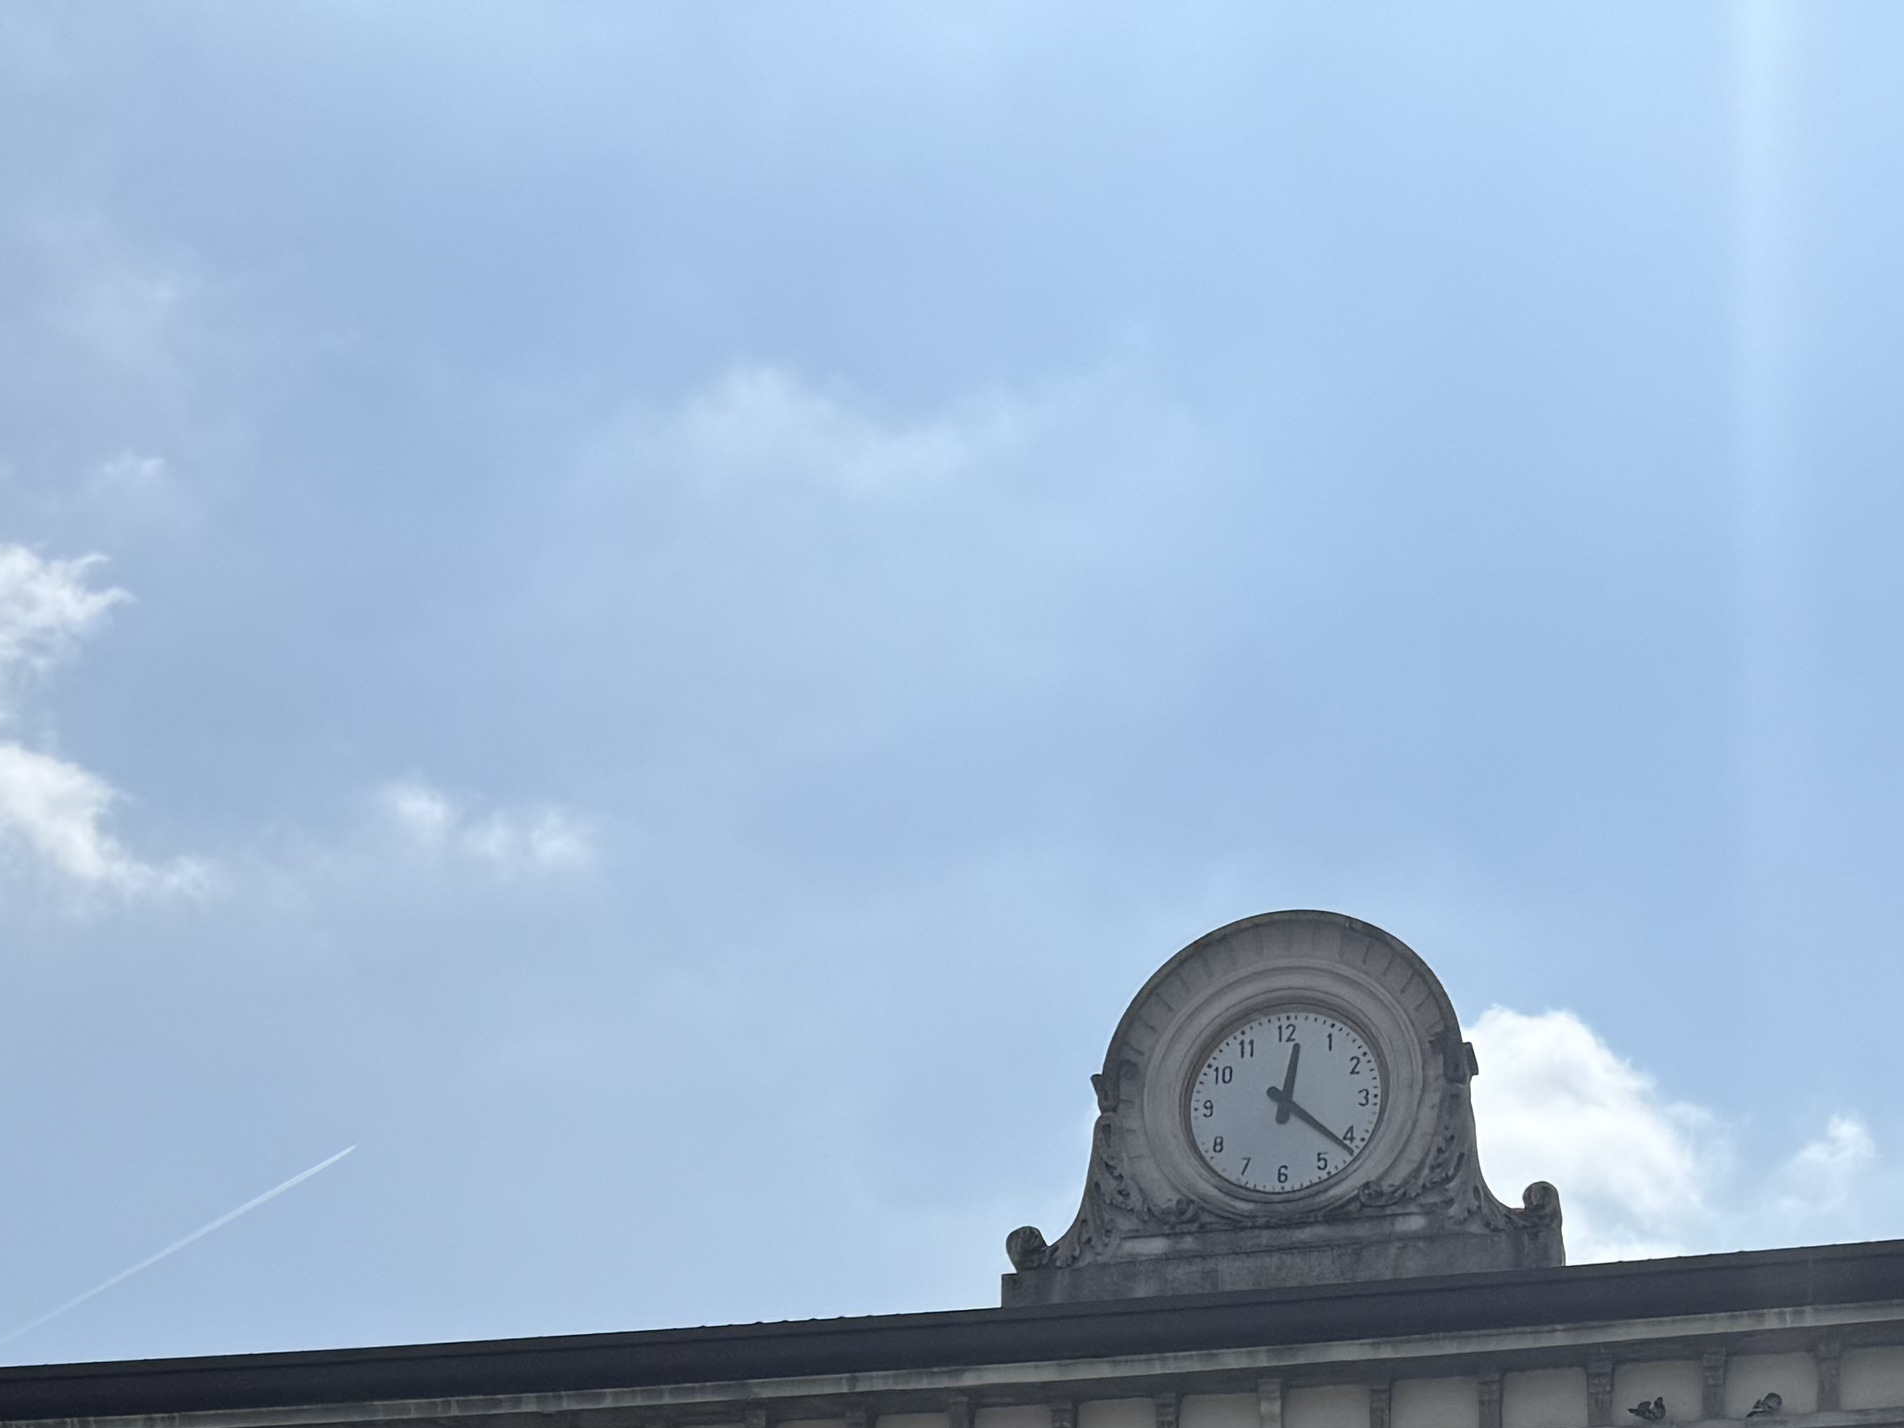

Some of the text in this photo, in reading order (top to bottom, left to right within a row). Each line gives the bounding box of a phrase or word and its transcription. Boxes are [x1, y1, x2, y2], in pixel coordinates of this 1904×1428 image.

[1277, 1024, 1296, 1043] 12
[1326, 1033, 1333, 1052] 1
[1239, 1039, 1255, 1059] 11
[1213, 1065, 1233, 1085] 10
[1349, 1056, 1361, 1075] 2
[1357, 1088, 1370, 1107] 3
[1202, 1100, 1214, 1118] 9
[1342, 1125, 1356, 1144] 4
[1212, 1136, 1224, 1153] 8
[1241, 1157, 1252, 1176] 7
[1316, 1152, 1329, 1171] 5
[1277, 1165, 1289, 1183] 6
